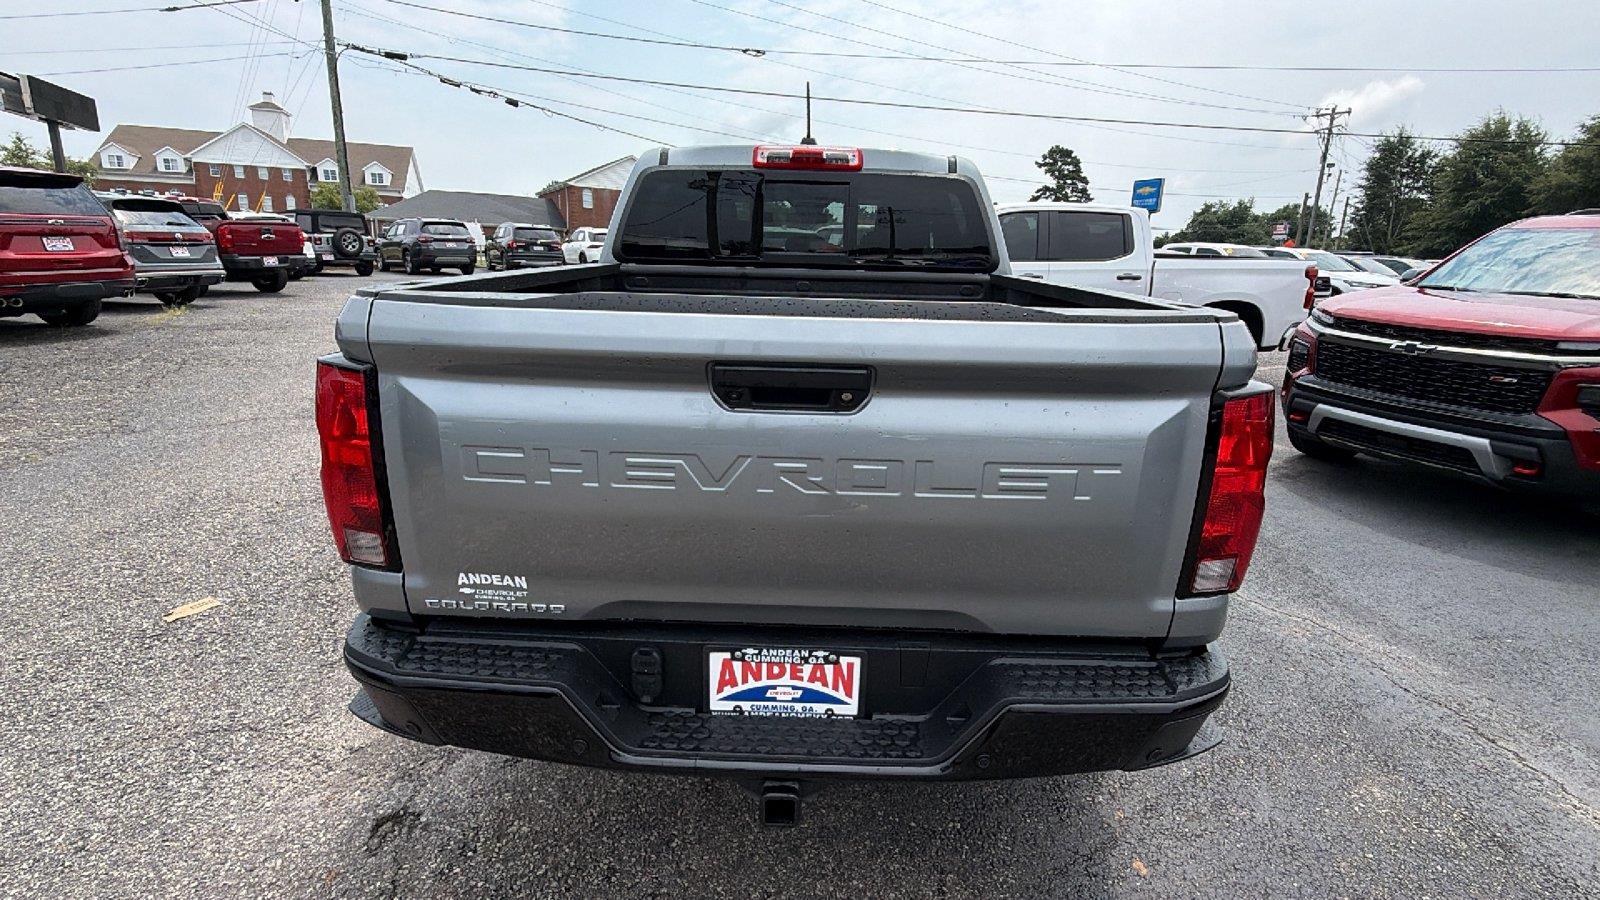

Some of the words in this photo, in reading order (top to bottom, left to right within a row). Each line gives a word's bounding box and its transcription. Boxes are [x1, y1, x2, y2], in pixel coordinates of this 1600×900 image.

[460, 444, 1123, 501] CHEVROLET
[458, 573, 527, 589] ANDEAN
[476, 590, 528, 598] CHEVROLET
[424, 599, 566, 613] COLORADO
[761, 649, 809, 658] ANDEAN
[808, 657, 825, 665] GA
[716, 658, 855, 699] ANDEAN
